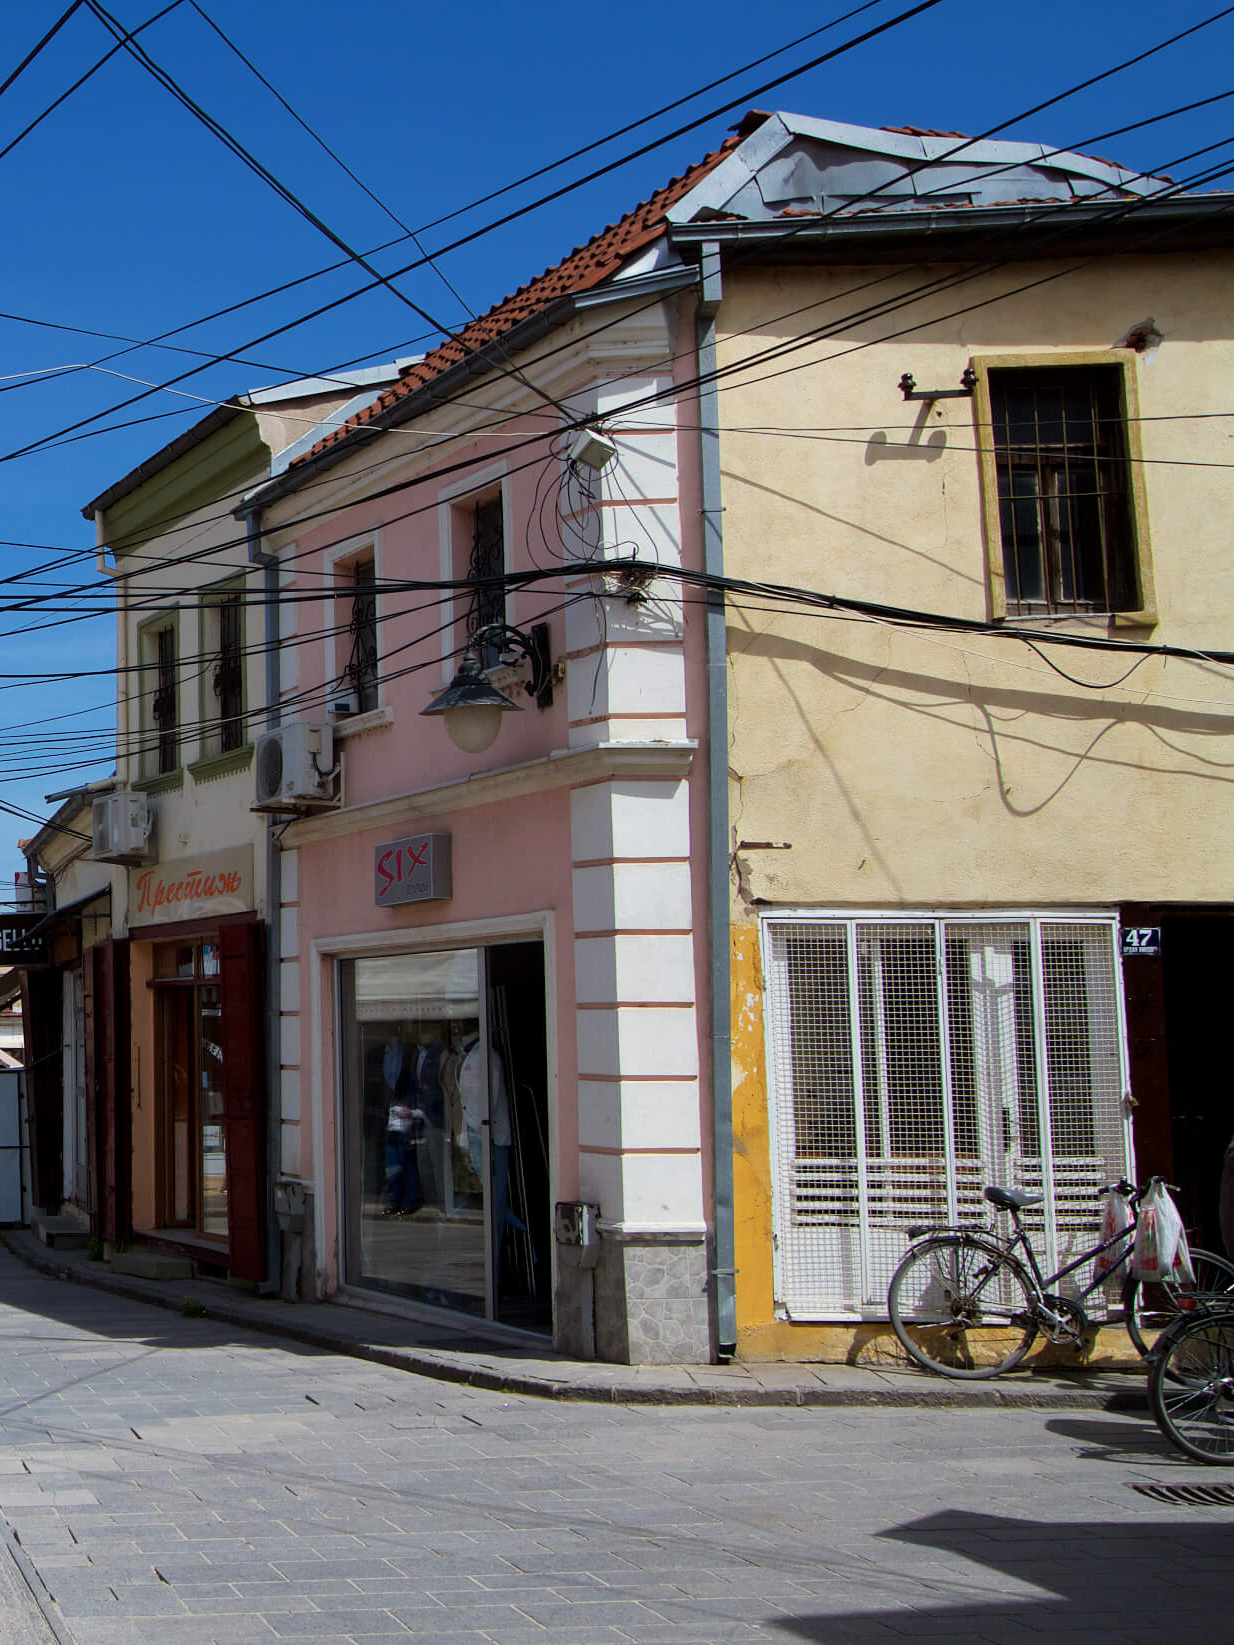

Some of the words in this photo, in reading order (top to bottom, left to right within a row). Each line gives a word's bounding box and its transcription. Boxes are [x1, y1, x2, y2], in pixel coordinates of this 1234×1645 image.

[377, 842, 429, 897] SIX
[136, 870, 242, 919] Престиж
[1126, 929, 1152, 947] 47
